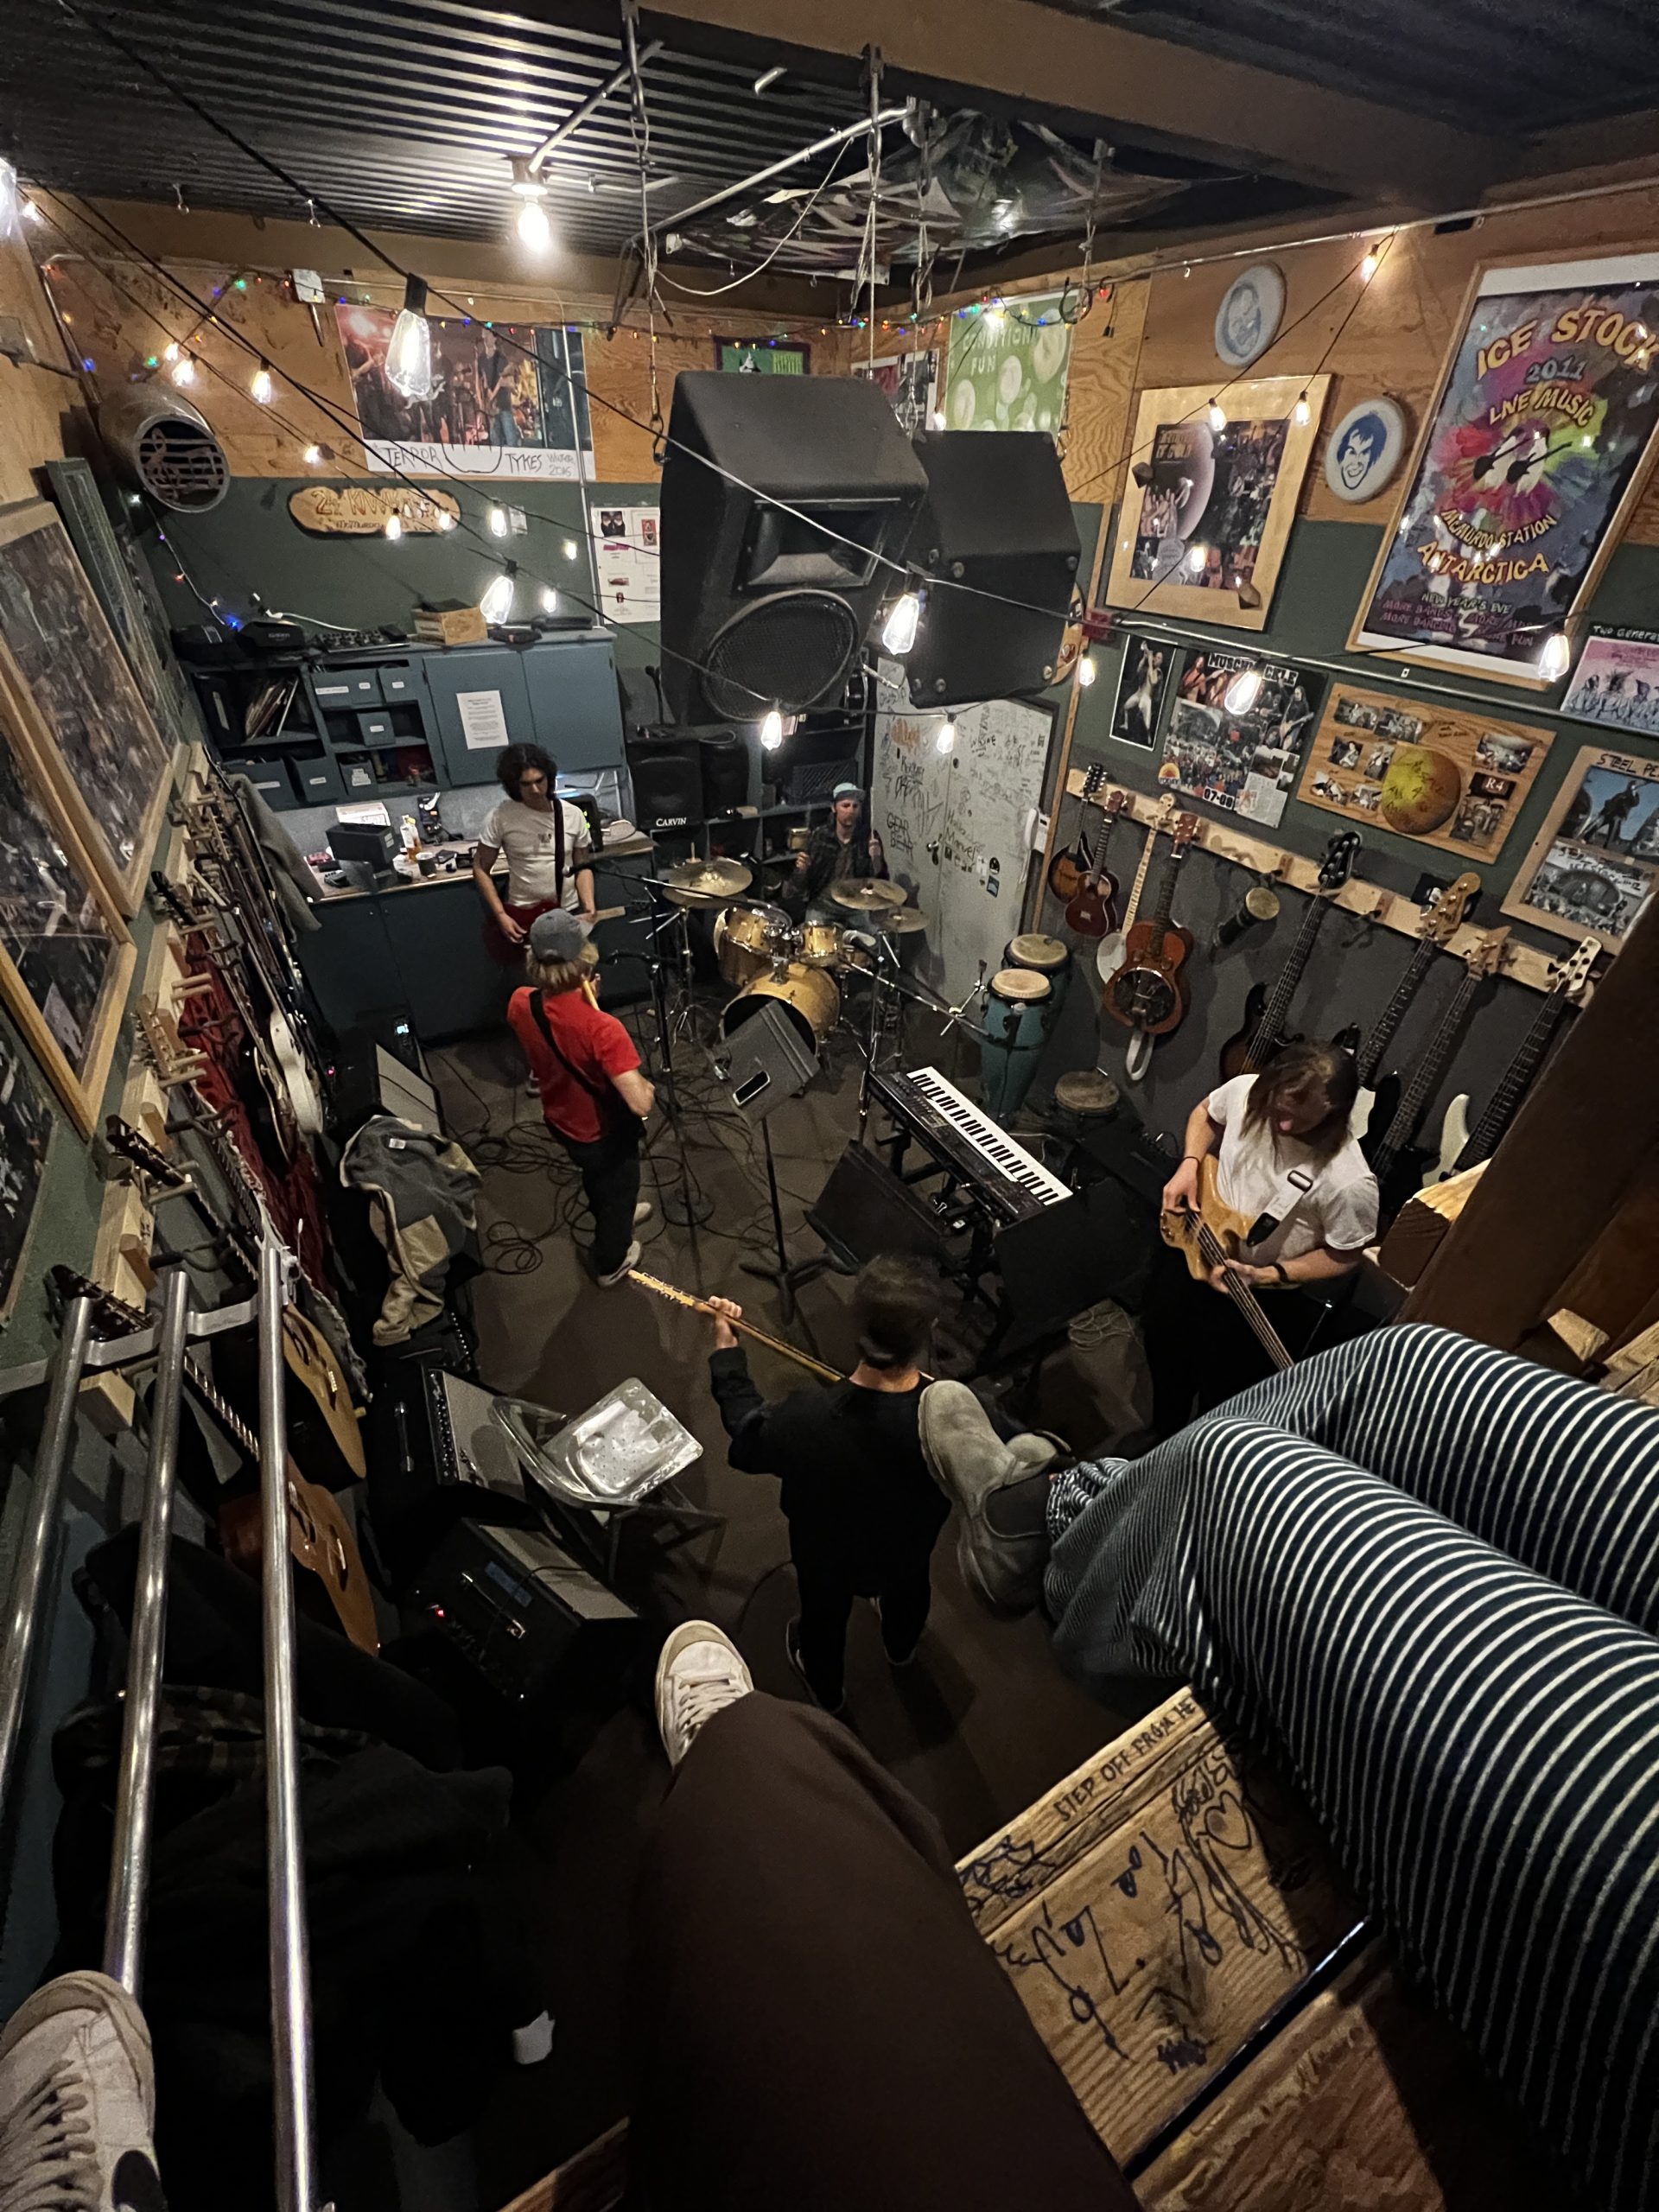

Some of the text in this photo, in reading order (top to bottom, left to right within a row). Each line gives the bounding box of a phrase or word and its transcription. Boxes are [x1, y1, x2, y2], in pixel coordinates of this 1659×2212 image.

[1477, 304, 1659, 380] ICE STOCK
[970, 355, 996, 376] FUN
[1525, 355, 1588, 385] 2011
[1489, 388, 1596, 427] LIVE MUSIC
[505, 453, 543, 474] TYKES
[1498, 513, 1558, 550] STATION
[1417, 539, 1550, 585] ANTARCTICA
[1421, 592, 1446, 605] NEW
[1592, 625, 1614, 635] Two
[1596, 753, 1659, 778] STEEL PE
[655, 817, 688, 827] CARVIN
[1052, 1776, 1095, 1822] STEP
[1099, 1748, 1131, 1782] OFF
[1130, 1716, 1176, 1757] FROM
